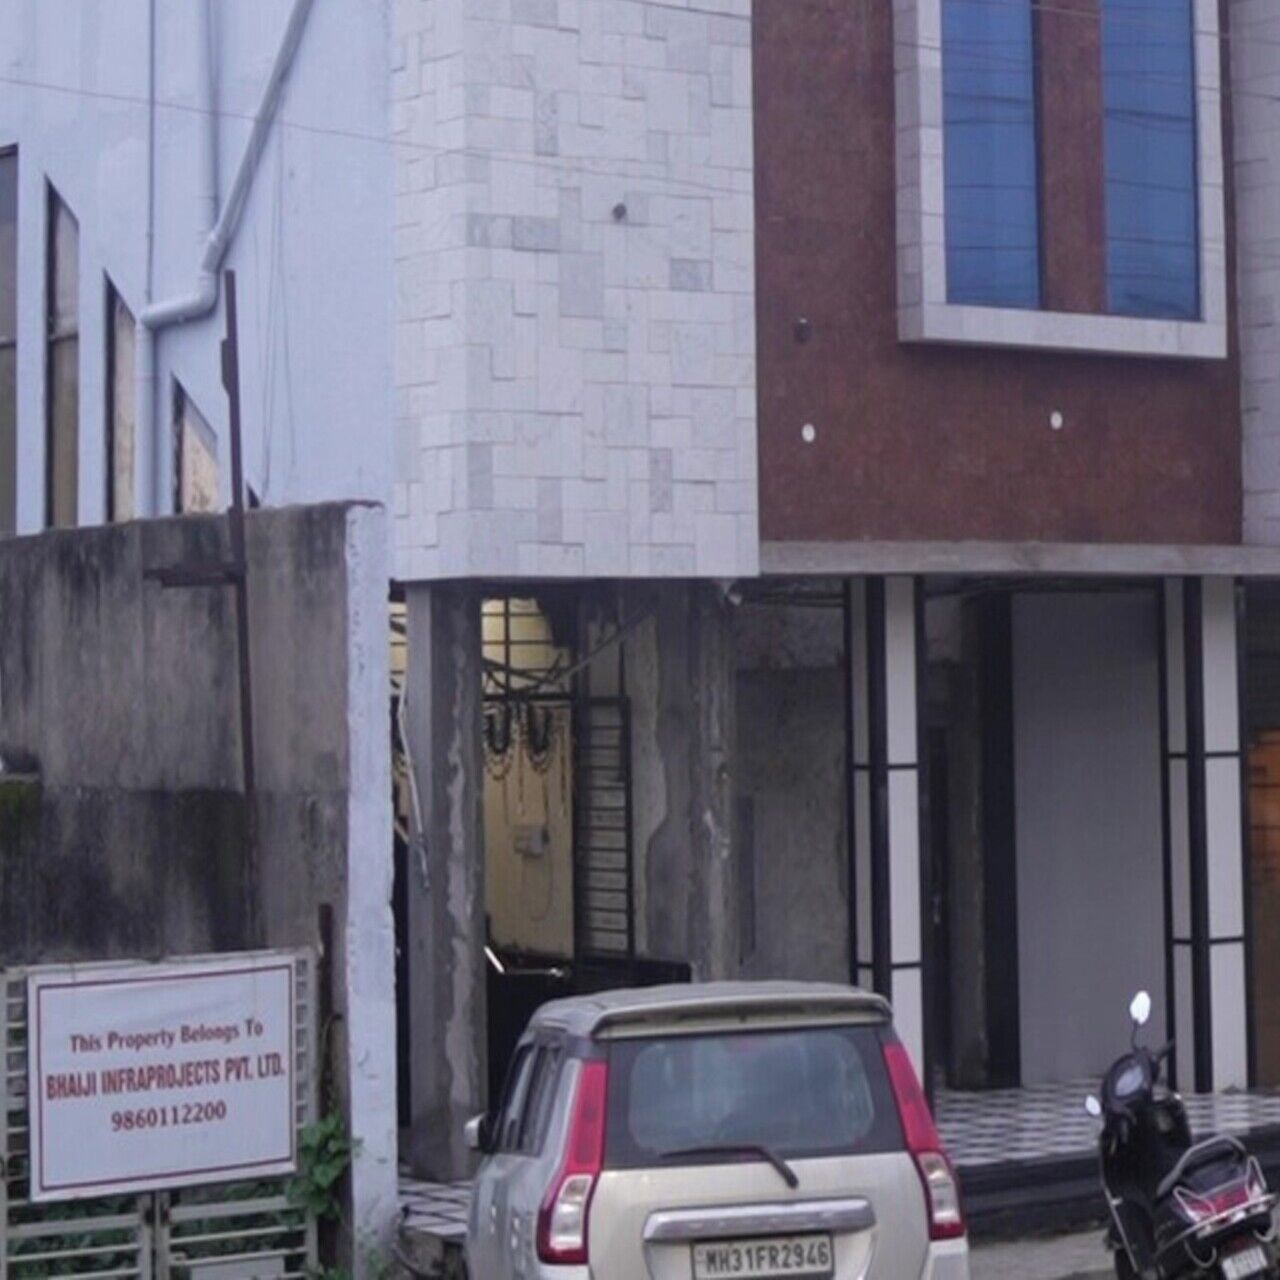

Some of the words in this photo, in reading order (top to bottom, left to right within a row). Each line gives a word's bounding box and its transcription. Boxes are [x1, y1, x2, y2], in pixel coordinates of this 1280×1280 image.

[70, 1033, 102, 1053] This
[107, 1029, 175, 1053] Property
[181, 1024, 240, 1044] Belongs
[245, 1018, 264, 1037] To
[46, 1072, 97, 1100] BHAIJI
[101, 1059, 221, 1095] INFRAPROJECTS
[225, 1056, 253, 1082] PVT.
[257, 1052, 286, 1078] LTD.
[111, 1099, 227, 1132] 9860112200
